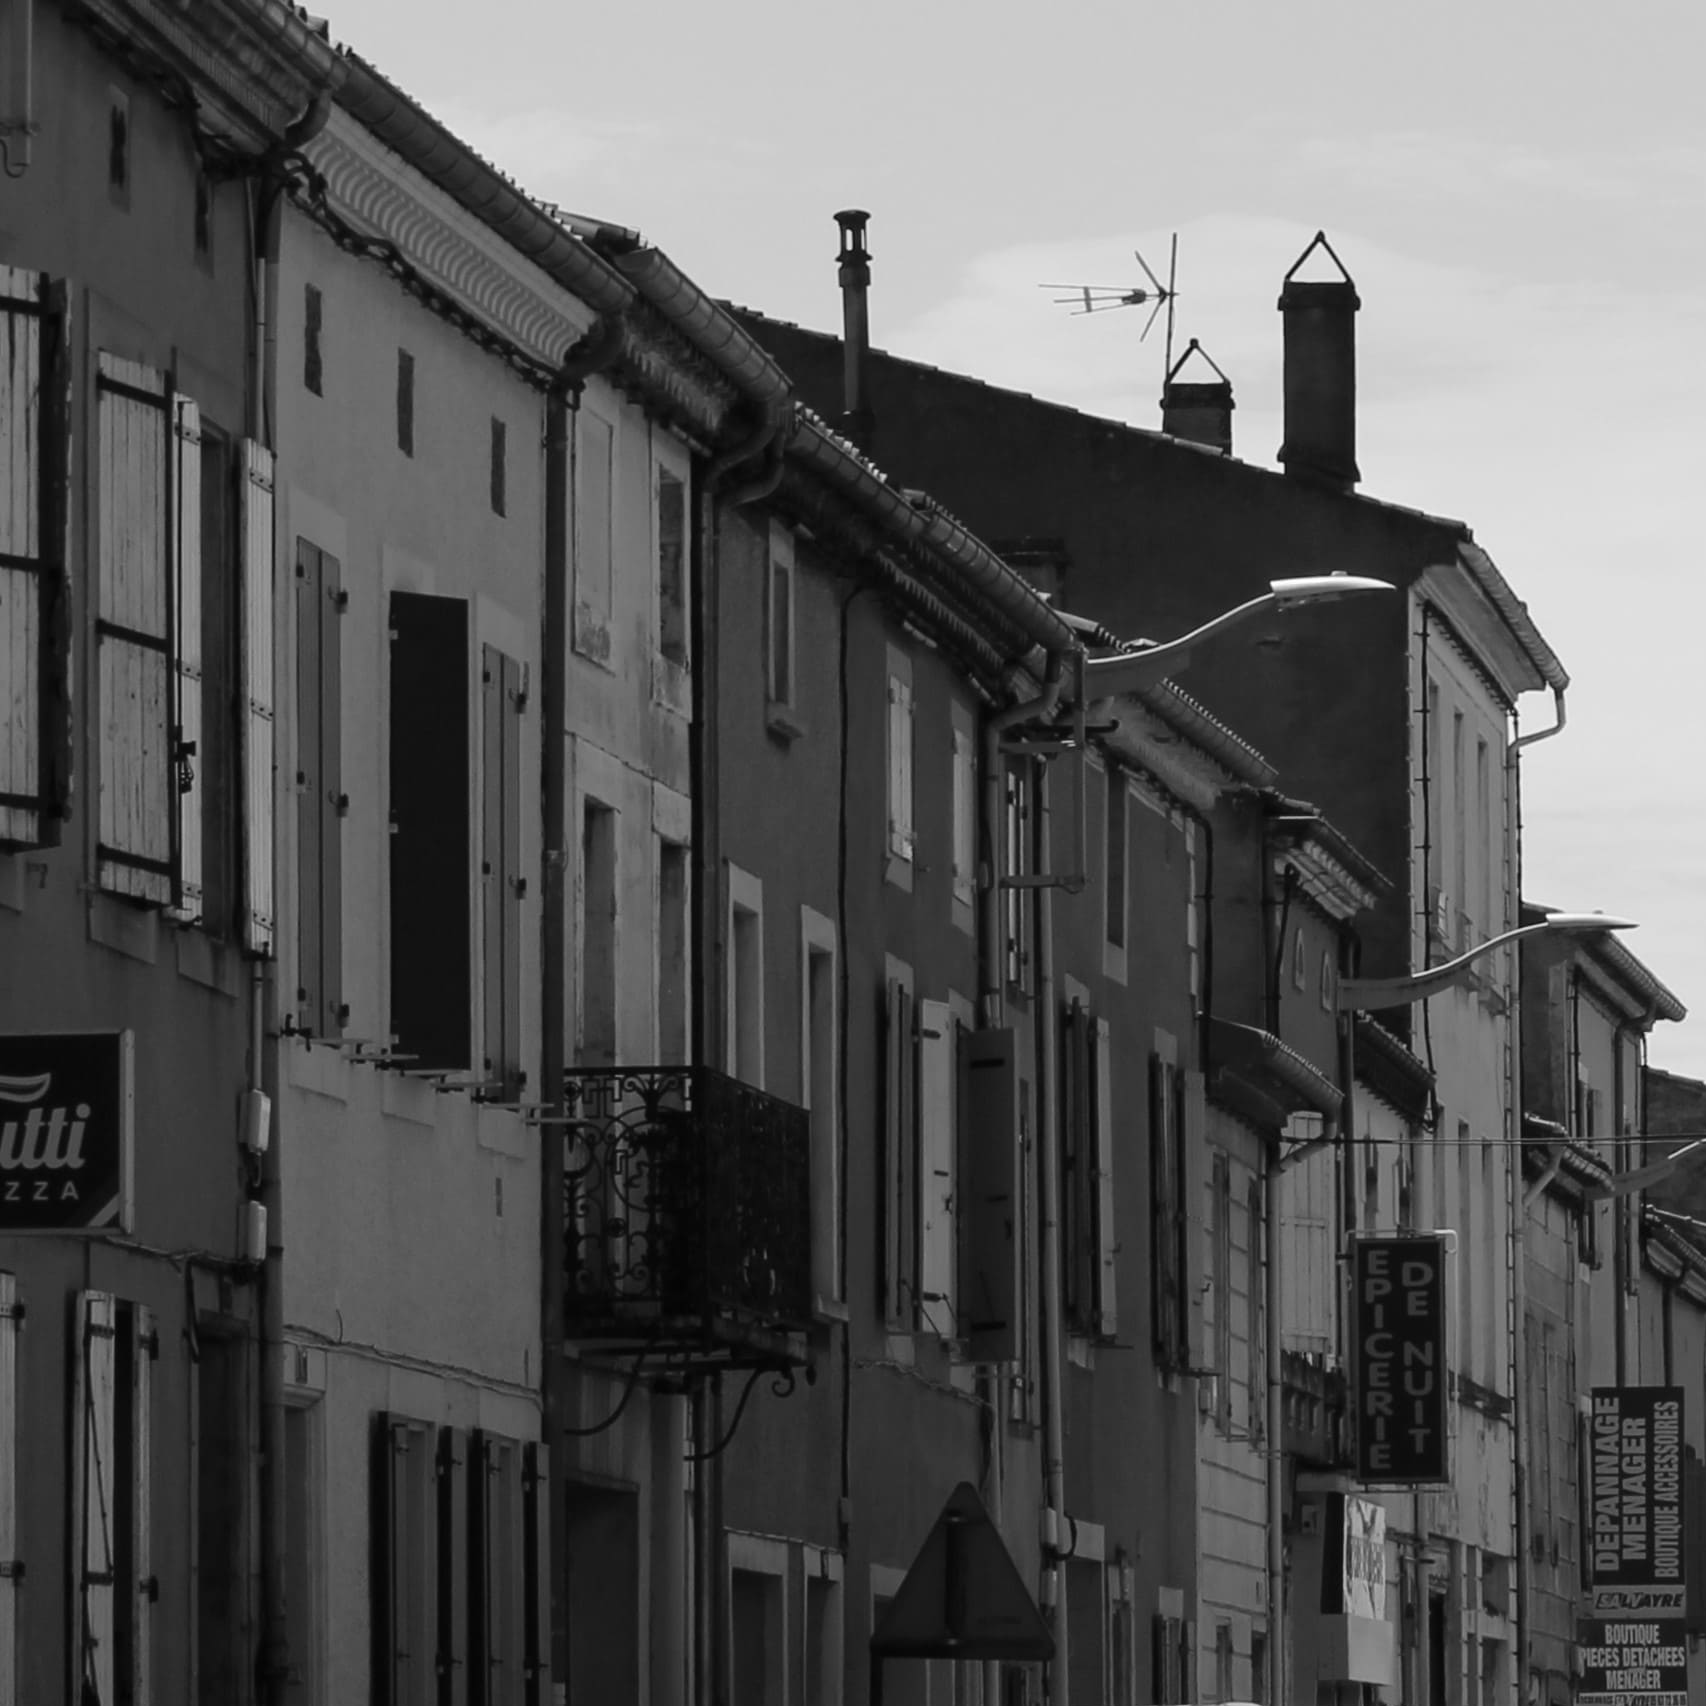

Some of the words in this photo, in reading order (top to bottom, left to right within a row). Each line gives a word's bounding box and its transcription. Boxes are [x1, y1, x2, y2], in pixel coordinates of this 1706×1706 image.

[1401, 1261, 1434, 1317] DE
[1364, 1249, 1395, 1469] EPICERIE
[1403, 1340, 1434, 1455] NUIT
[1594, 1396, 1620, 1572] DEPANNAGE
[1654, 1401, 1680, 1503] ACCESSOIRES
[1621, 1417, 1647, 1561] MENAGER
[1654, 1506, 1682, 1578] BOUTIQUE
[1596, 1592, 1684, 1610] SALVAYRE
[1604, 1623, 1661, 1646] BOUTIQUE
[1579, 1647, 1620, 1668] PIECES
[1622, 1646, 1686, 1668] DETACHEES
[1605, 1669, 1662, 1690] MENAGER
